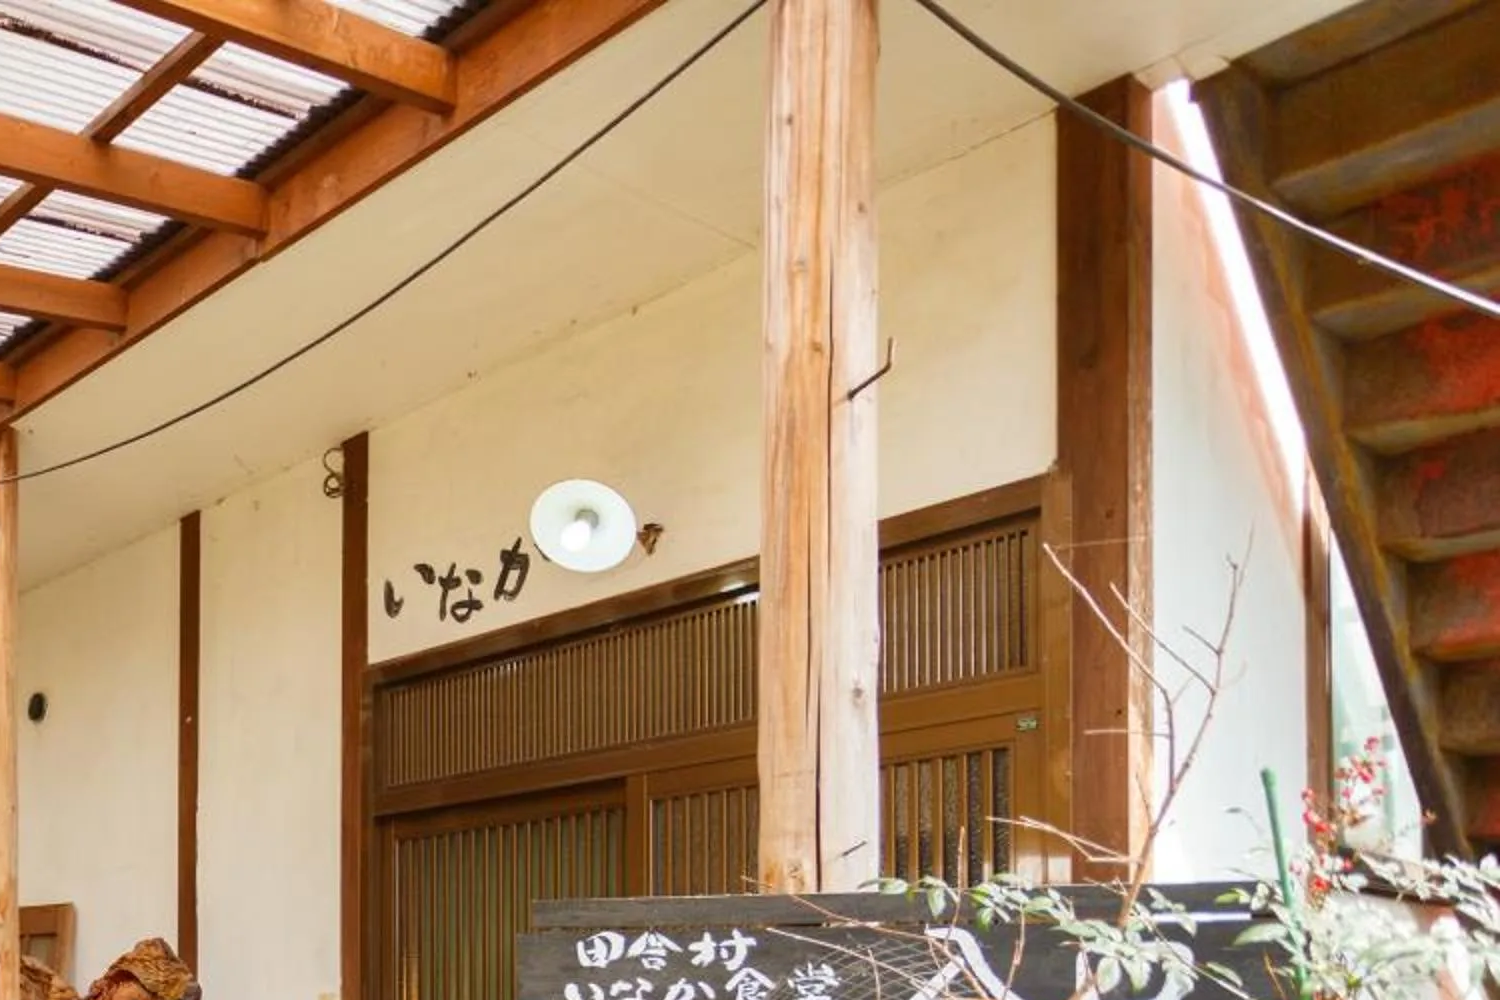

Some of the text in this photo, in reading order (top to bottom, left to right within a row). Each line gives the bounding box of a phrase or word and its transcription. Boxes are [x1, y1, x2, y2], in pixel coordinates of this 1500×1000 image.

[384, 536, 551, 624] いなか
[578, 930, 758, 970] 田舎村
